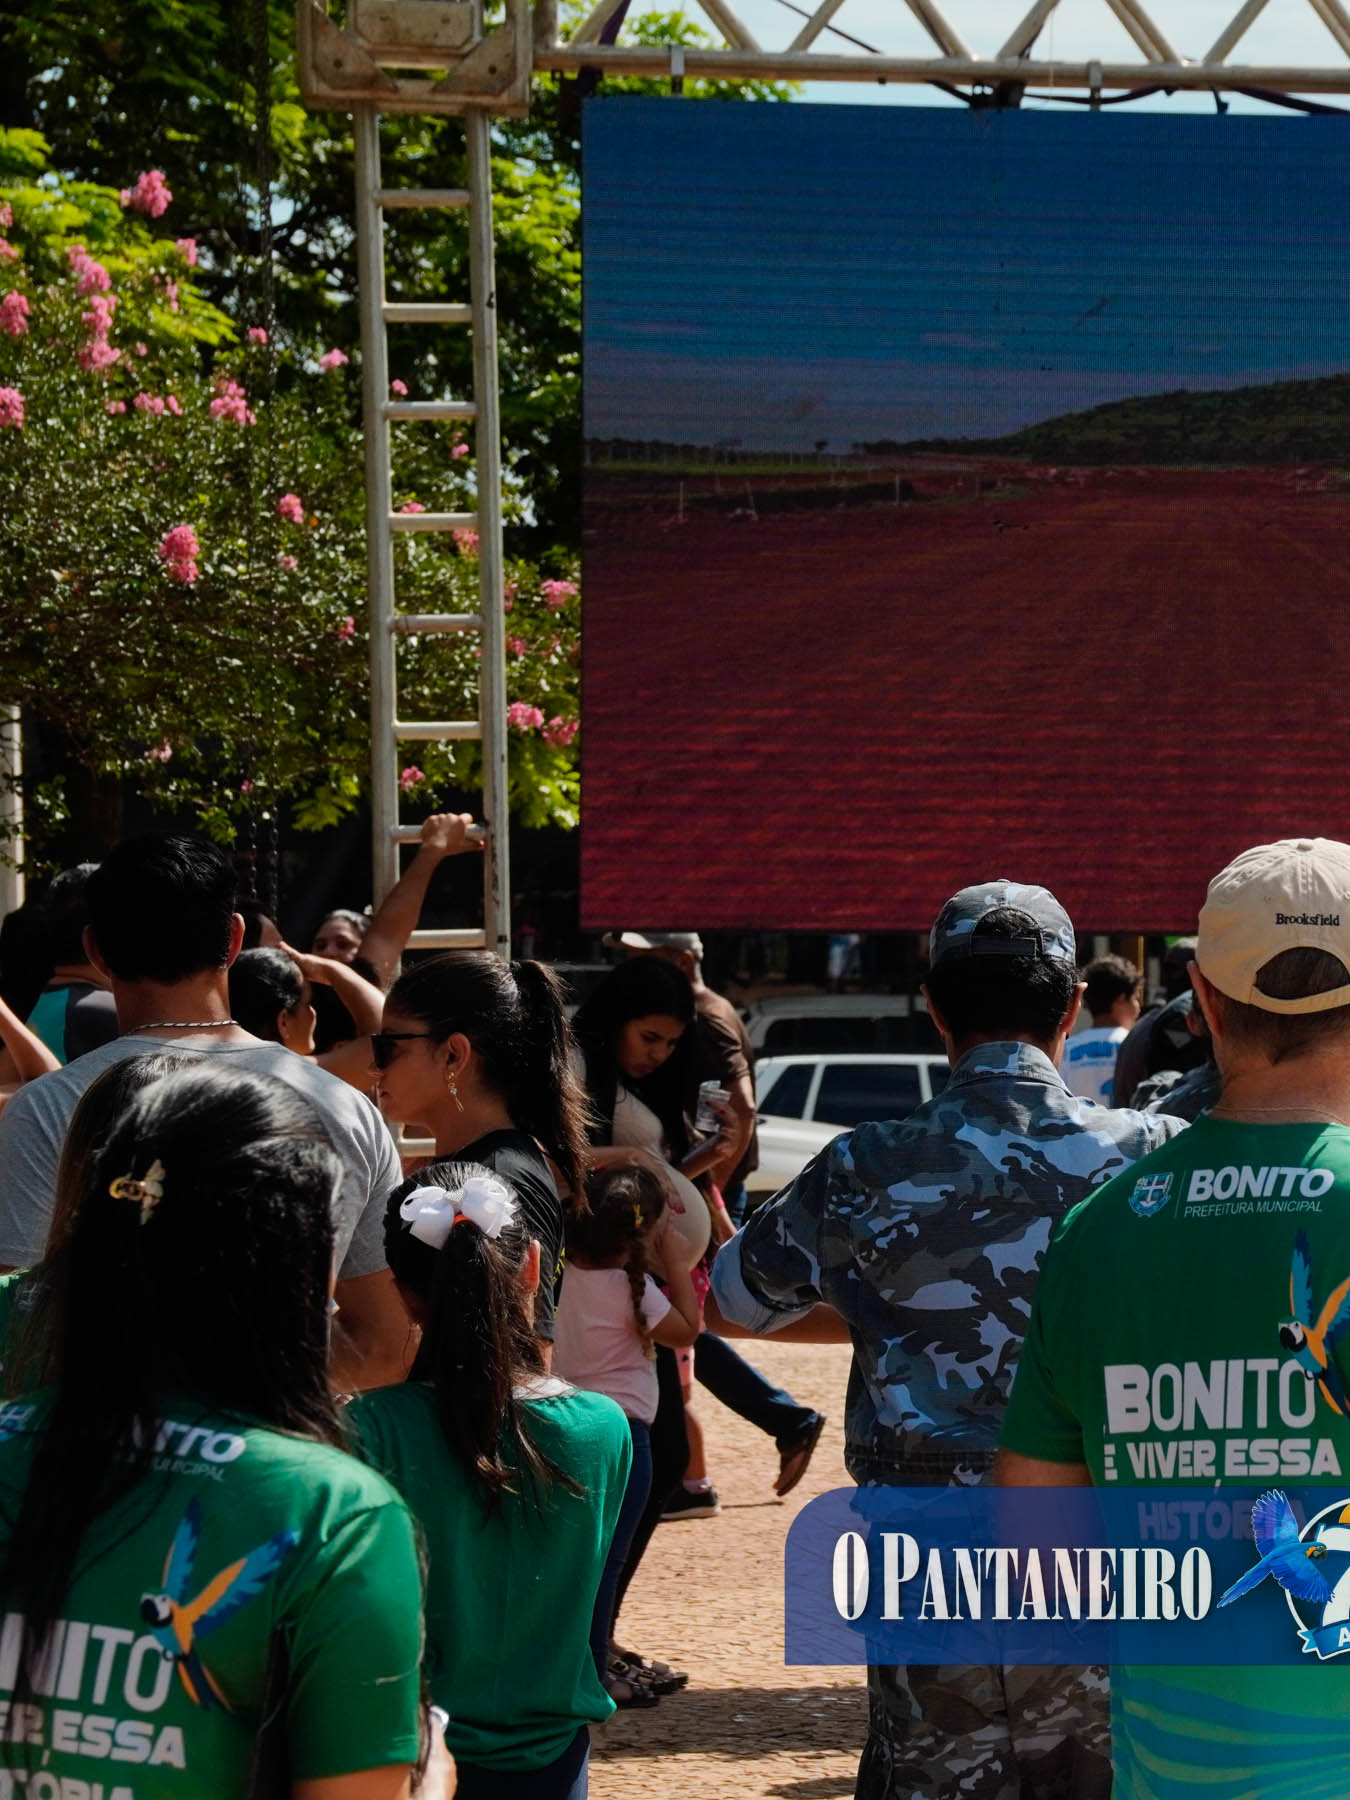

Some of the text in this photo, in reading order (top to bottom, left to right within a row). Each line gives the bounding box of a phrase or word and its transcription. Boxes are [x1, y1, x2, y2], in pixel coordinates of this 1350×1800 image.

[1275, 912, 1340, 926] Brooksfield
[1187, 1165, 1335, 1202] BONITO
[1184, 1200, 1323, 1219] PREFEITURA MUNICIPAL
[1104, 1358, 1316, 1434] BONITO
[1126, 1440, 1216, 1479] VIVER
[1225, 1438, 1342, 1477] ESSA
[52, 1708, 186, 1769] ESSA
